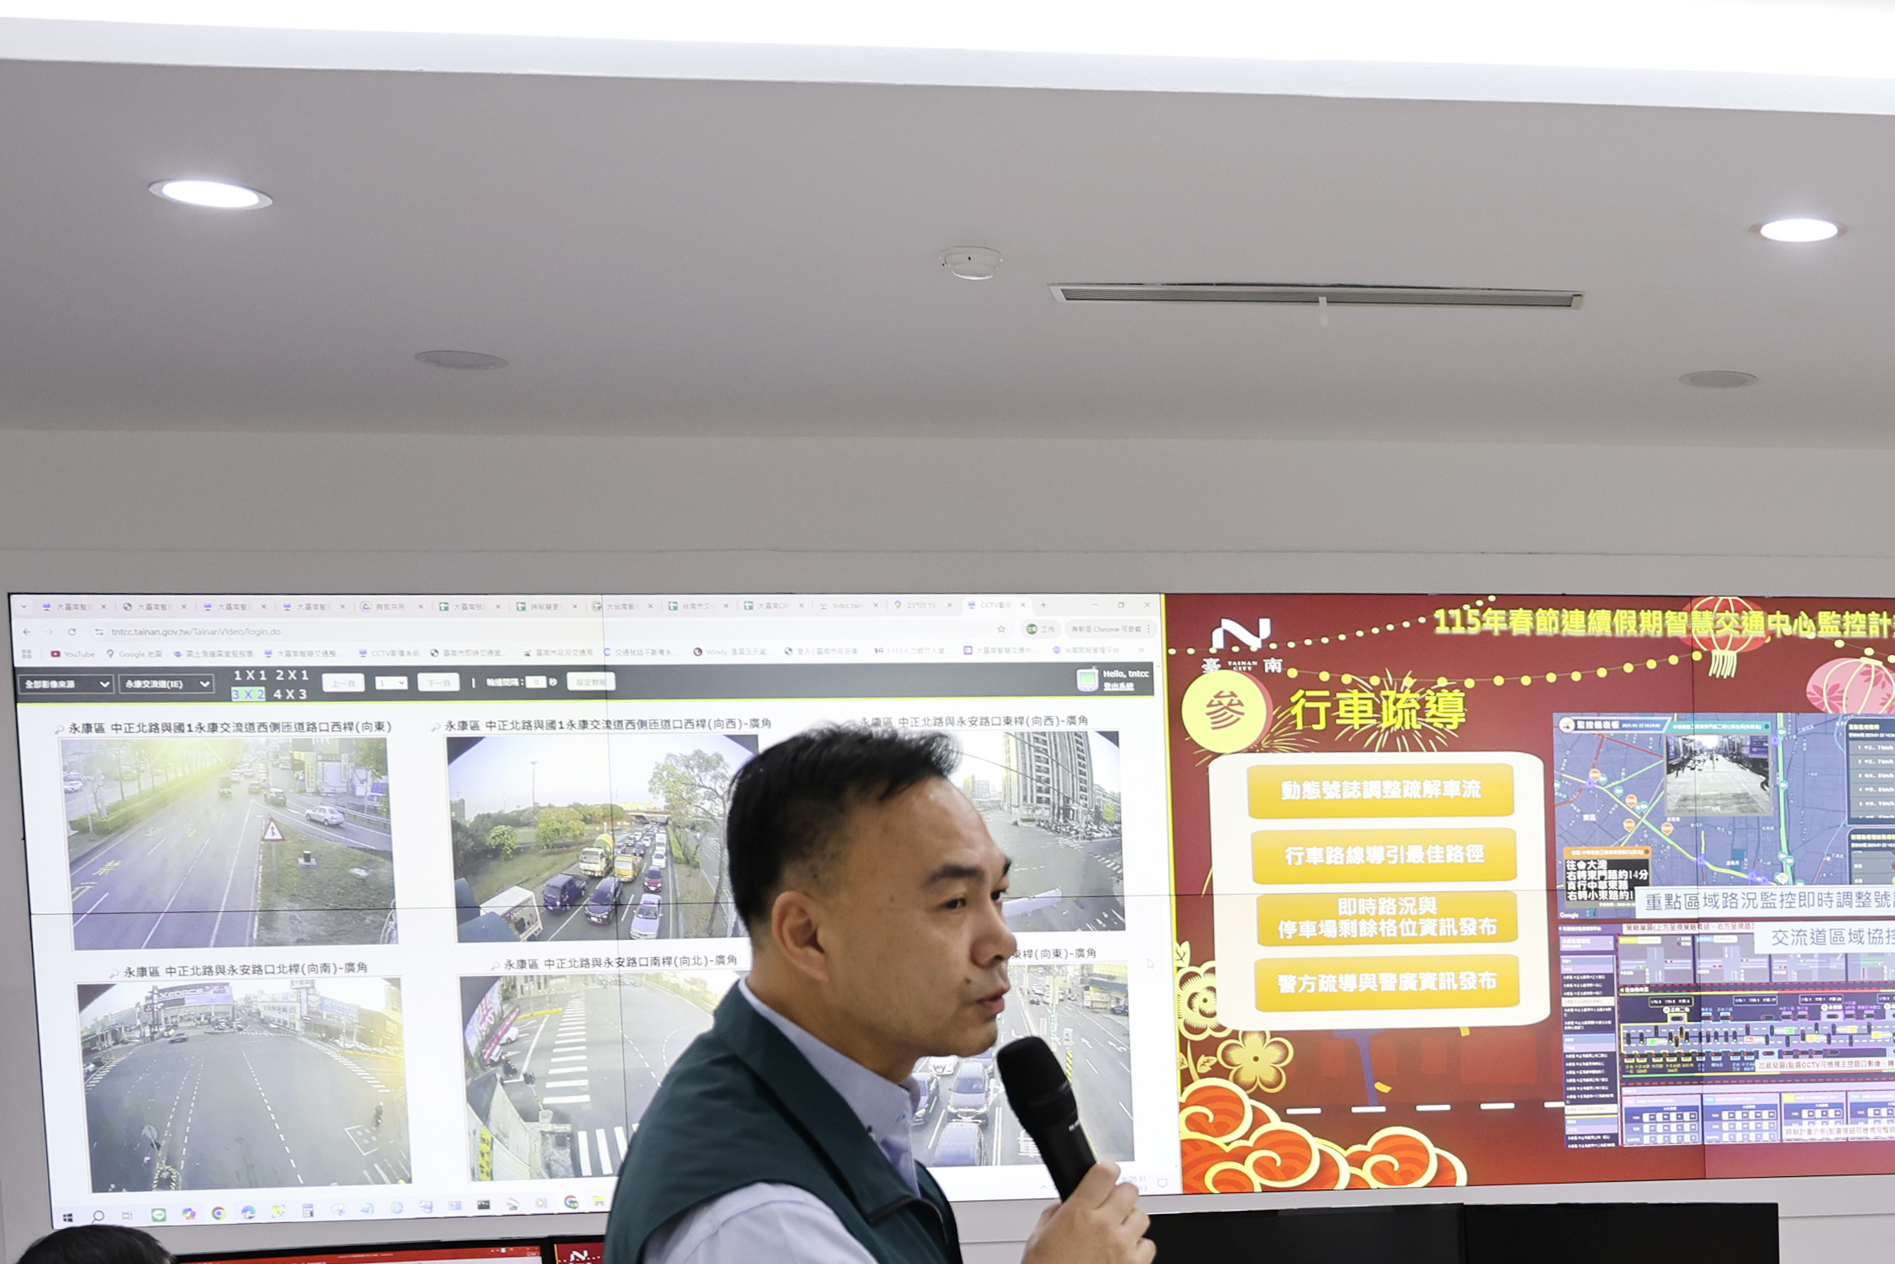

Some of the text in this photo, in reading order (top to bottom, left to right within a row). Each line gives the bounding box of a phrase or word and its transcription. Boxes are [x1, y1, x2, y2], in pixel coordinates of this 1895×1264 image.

[112, 628, 281, 637] tntcc.tainan.gov.tw/TainanVideo/login.do
[1104, 670, 1149, 678] Hello, tntcc
[1205, 690, 1245, 730] 參
[1290, 689, 1466, 730] 行車疏導
[69, 723, 106, 734] 永康區
[445, 720, 480, 731] 永康區
[1281, 780, 1481, 800] 動態號誌調整疏解車流
[1285, 844, 1485, 865] 行車路線導引最佳路徑
[1566, 870, 1649, 880] 右轉東門路約14分
[1338, 897, 1438, 916] 即時路況與
[1560, 911, 1579, 919] Google
[1278, 918, 1497, 939] 停車場剩餘格位資訊發布
[504, 959, 539, 970] 永康區
[124, 966, 160, 978] 永康區
[1278, 971, 1497, 993] 警方疏導與警廣資訊發布
